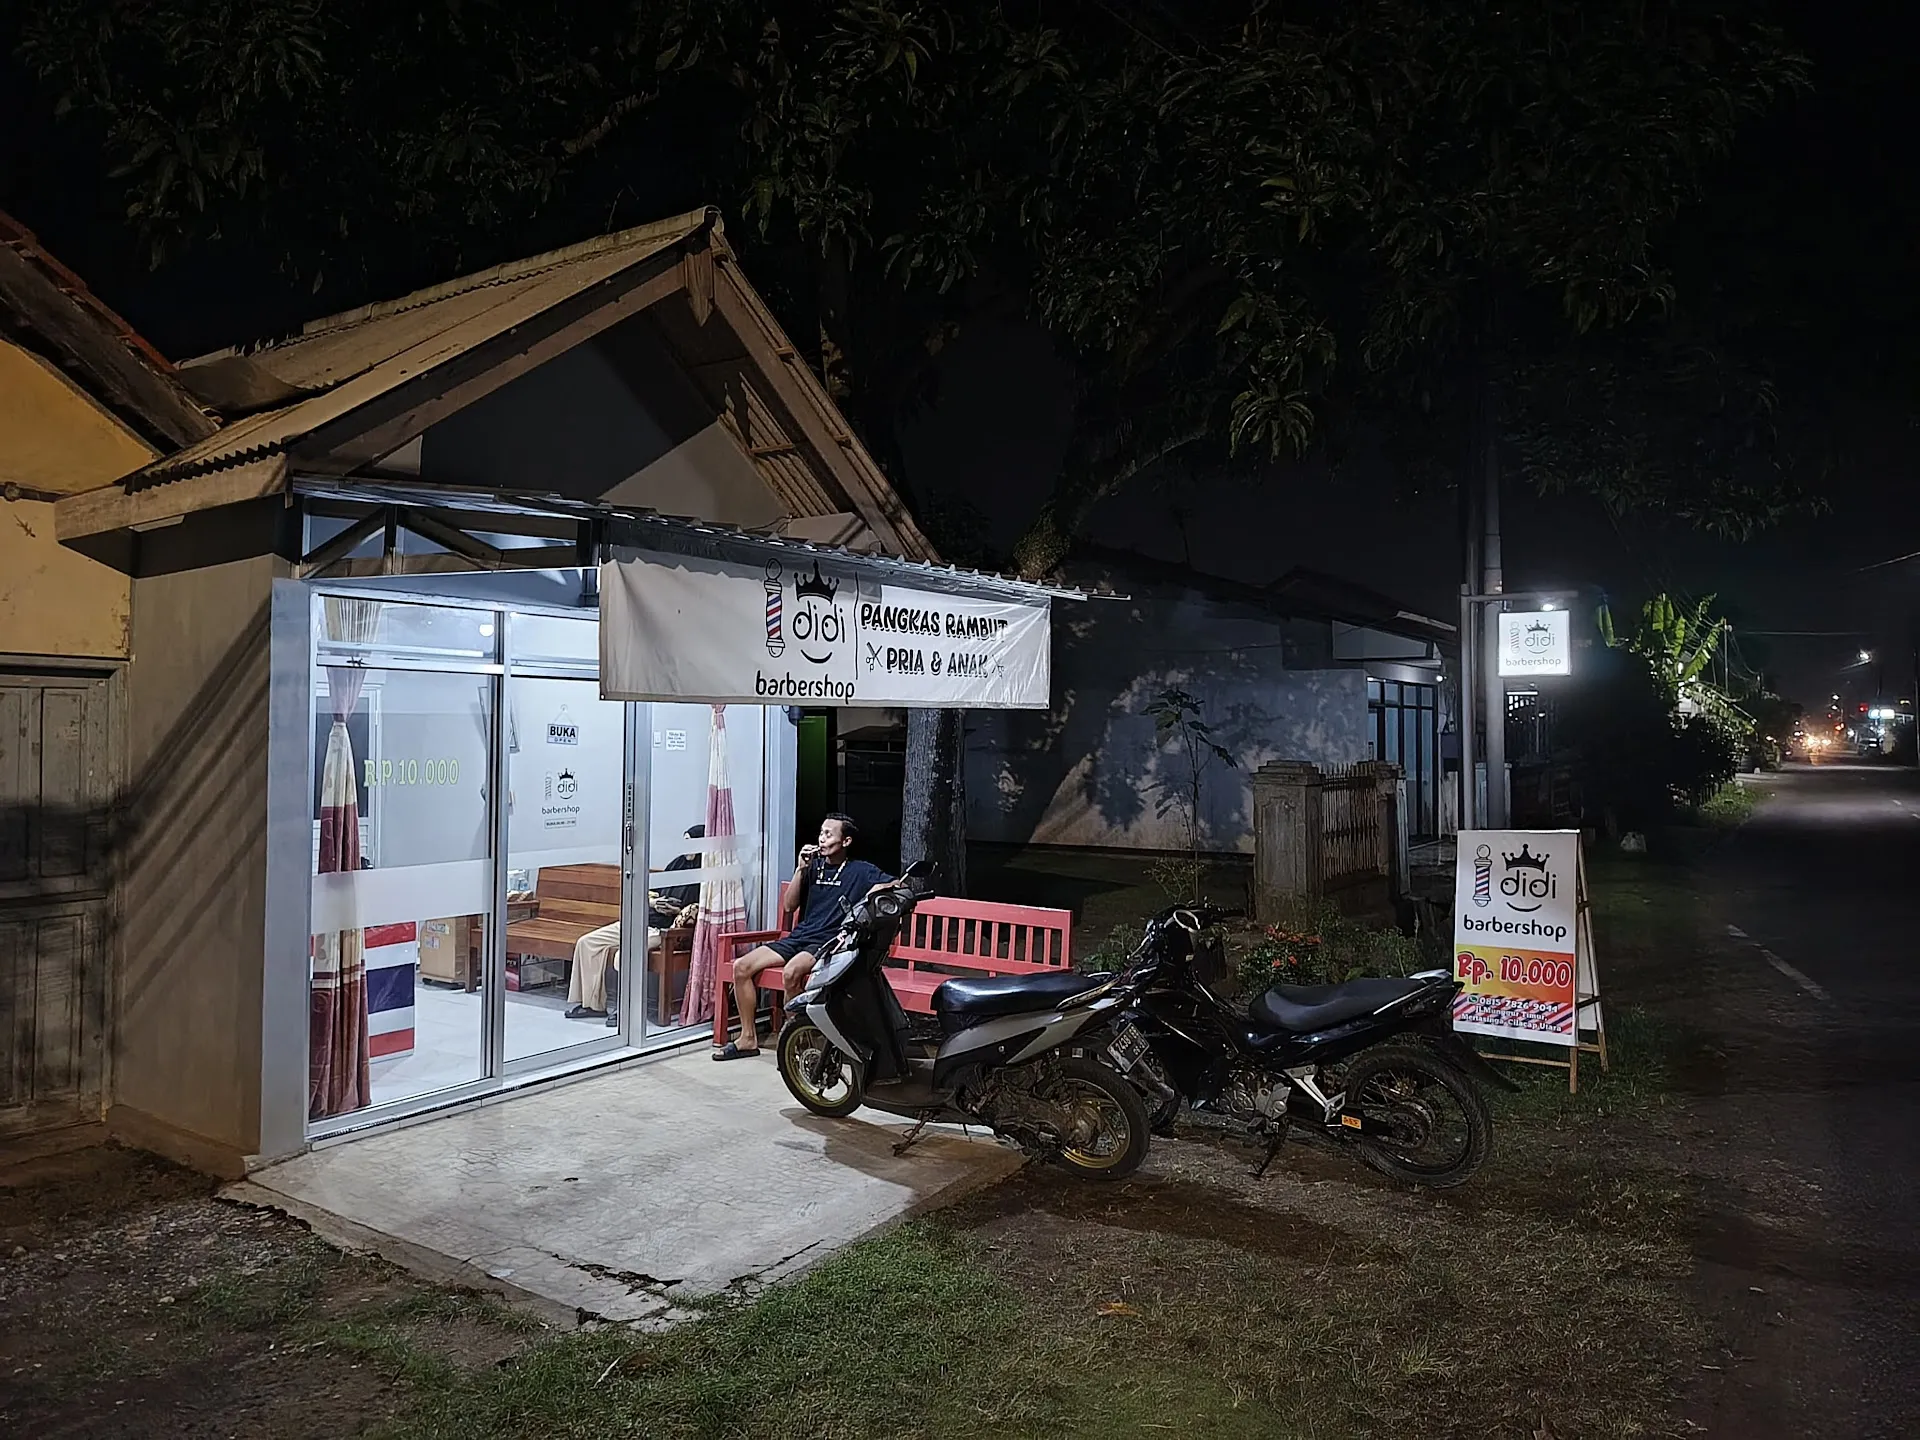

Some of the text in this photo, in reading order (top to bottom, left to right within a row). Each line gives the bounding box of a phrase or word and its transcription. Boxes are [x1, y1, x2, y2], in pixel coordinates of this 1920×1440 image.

[793, 600, 845, 643] didi
[861, 603, 1008, 643] PANGKAS RAMBUT
[1524, 633, 1555, 647] didi
[886, 647, 989, 678] PRIA & ANAK
[1505, 657, 1561, 668] barbershop
[756, 670, 855, 705] barbershop
[550, 726, 576, 738] BUKA
[557, 780, 578, 793] didi
[541, 804, 580, 814] barbershop
[1500, 869, 1557, 899] didi
[1463, 914, 1567, 942] barbershop
[1457, 951, 1573, 988] Rp. 10.000
[1479, 997, 1501, 1006] 0815
[1505, 1000, 1529, 1010] 7826
